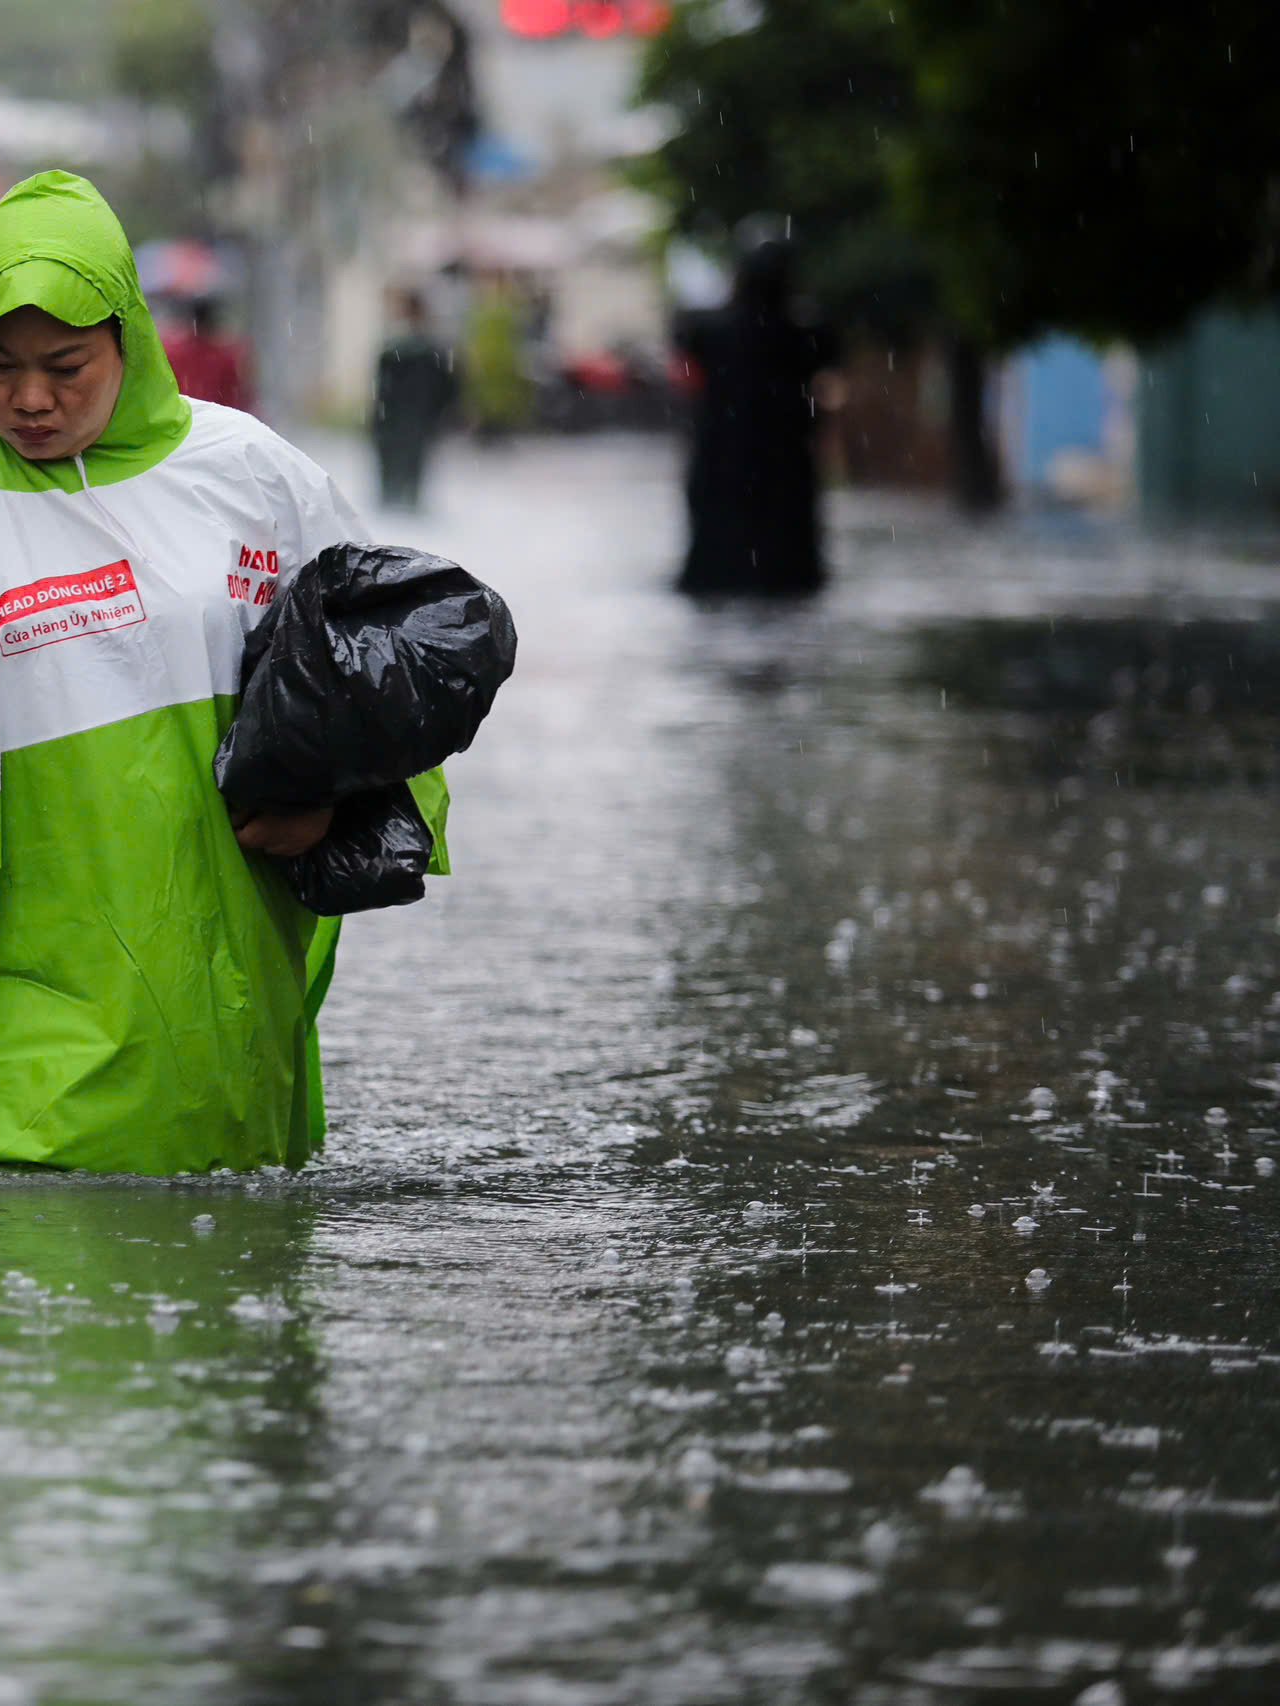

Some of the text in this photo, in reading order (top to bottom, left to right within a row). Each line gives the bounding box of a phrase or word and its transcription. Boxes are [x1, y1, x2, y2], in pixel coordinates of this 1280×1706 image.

[37, 583, 82, 604] ĐÔNG
[84, 575, 115, 596] HUỆ
[117, 572, 128, 586] 2
[4, 603, 136, 645] Cửa Hàng Ủy Nhiệm
